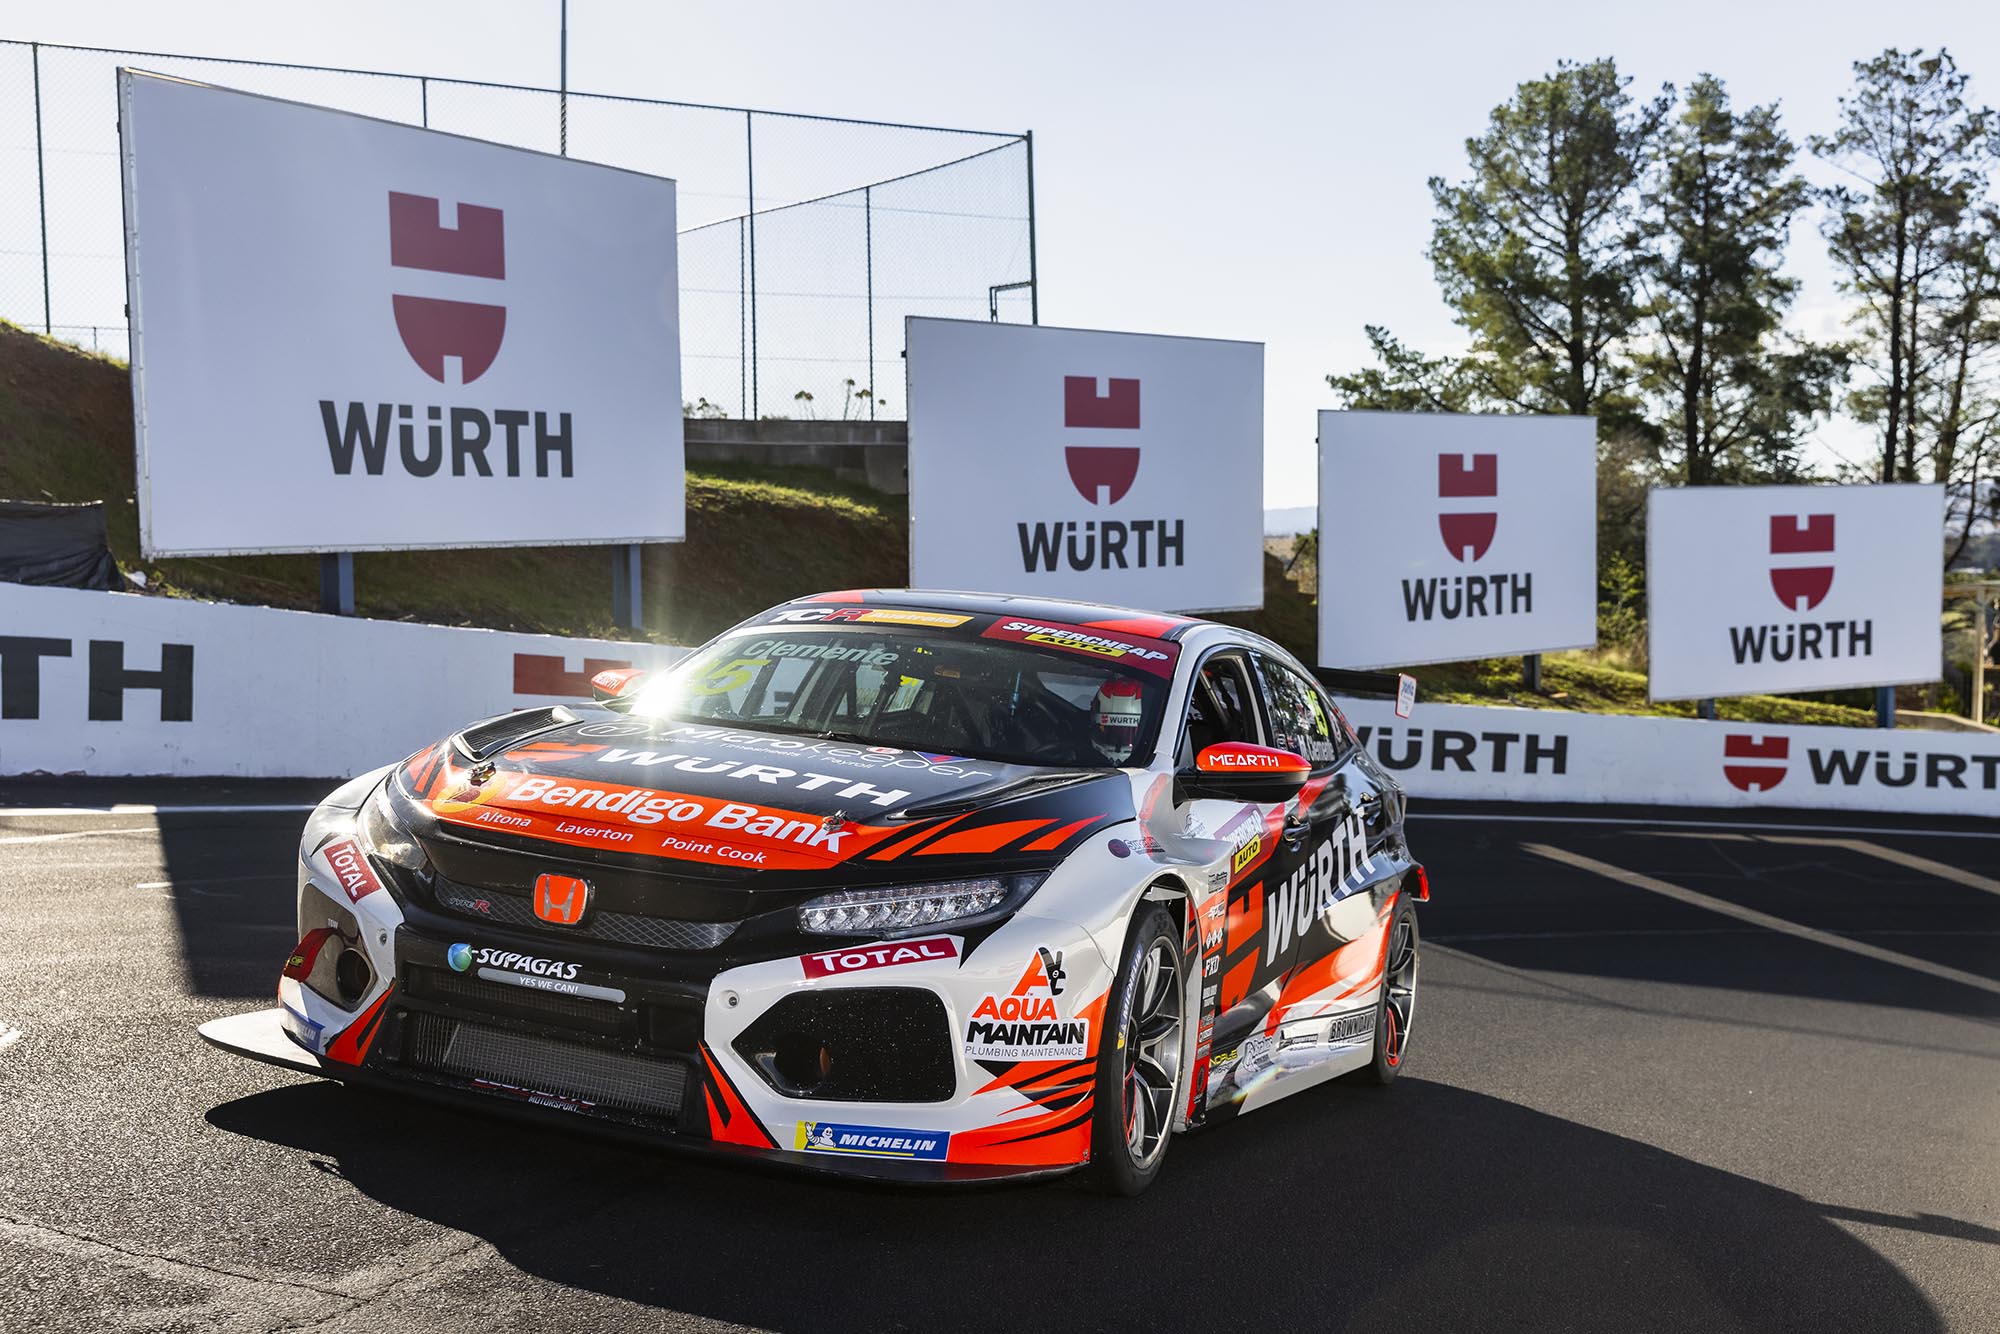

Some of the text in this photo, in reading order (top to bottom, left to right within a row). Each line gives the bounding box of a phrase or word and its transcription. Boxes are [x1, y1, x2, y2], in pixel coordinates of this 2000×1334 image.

[319, 400, 574, 478] WÜRTH
[1017, 519, 1184, 573] WÜRTH
[1402, 572, 1533, 622] WÜRTH
[769, 608, 875, 624] TCR
[743, 640, 899, 665] Clemente
[1002, 621, 1168, 661] SUPERCHEAP
[1039, 636, 1112, 654] AUTO
[1730, 619, 1873, 665] WÜRTH
[1209, 754, 1279, 767] MEARTH
[507, 778, 853, 854] Bendigo Bank
[476, 811, 767, 865] Altona Laverton Point Cook
[1237, 841, 1258, 867] AUTO
[331, 844, 368, 898] TOTAL
[477, 947, 583, 980] SUPAGAS
[812, 944, 945, 972] TOTAL
[519, 976, 579, 994] YES WE CAN!
[972, 995, 1057, 1021] AQUA
[966, 1020, 1086, 1046] MAINTAIN
[965, 1045, 1083, 1057] PLUMBING MAINTENANCE
[528, 1095, 579, 1112] MOTORSPORT
[838, 1133, 937, 1152] MICHELIN
